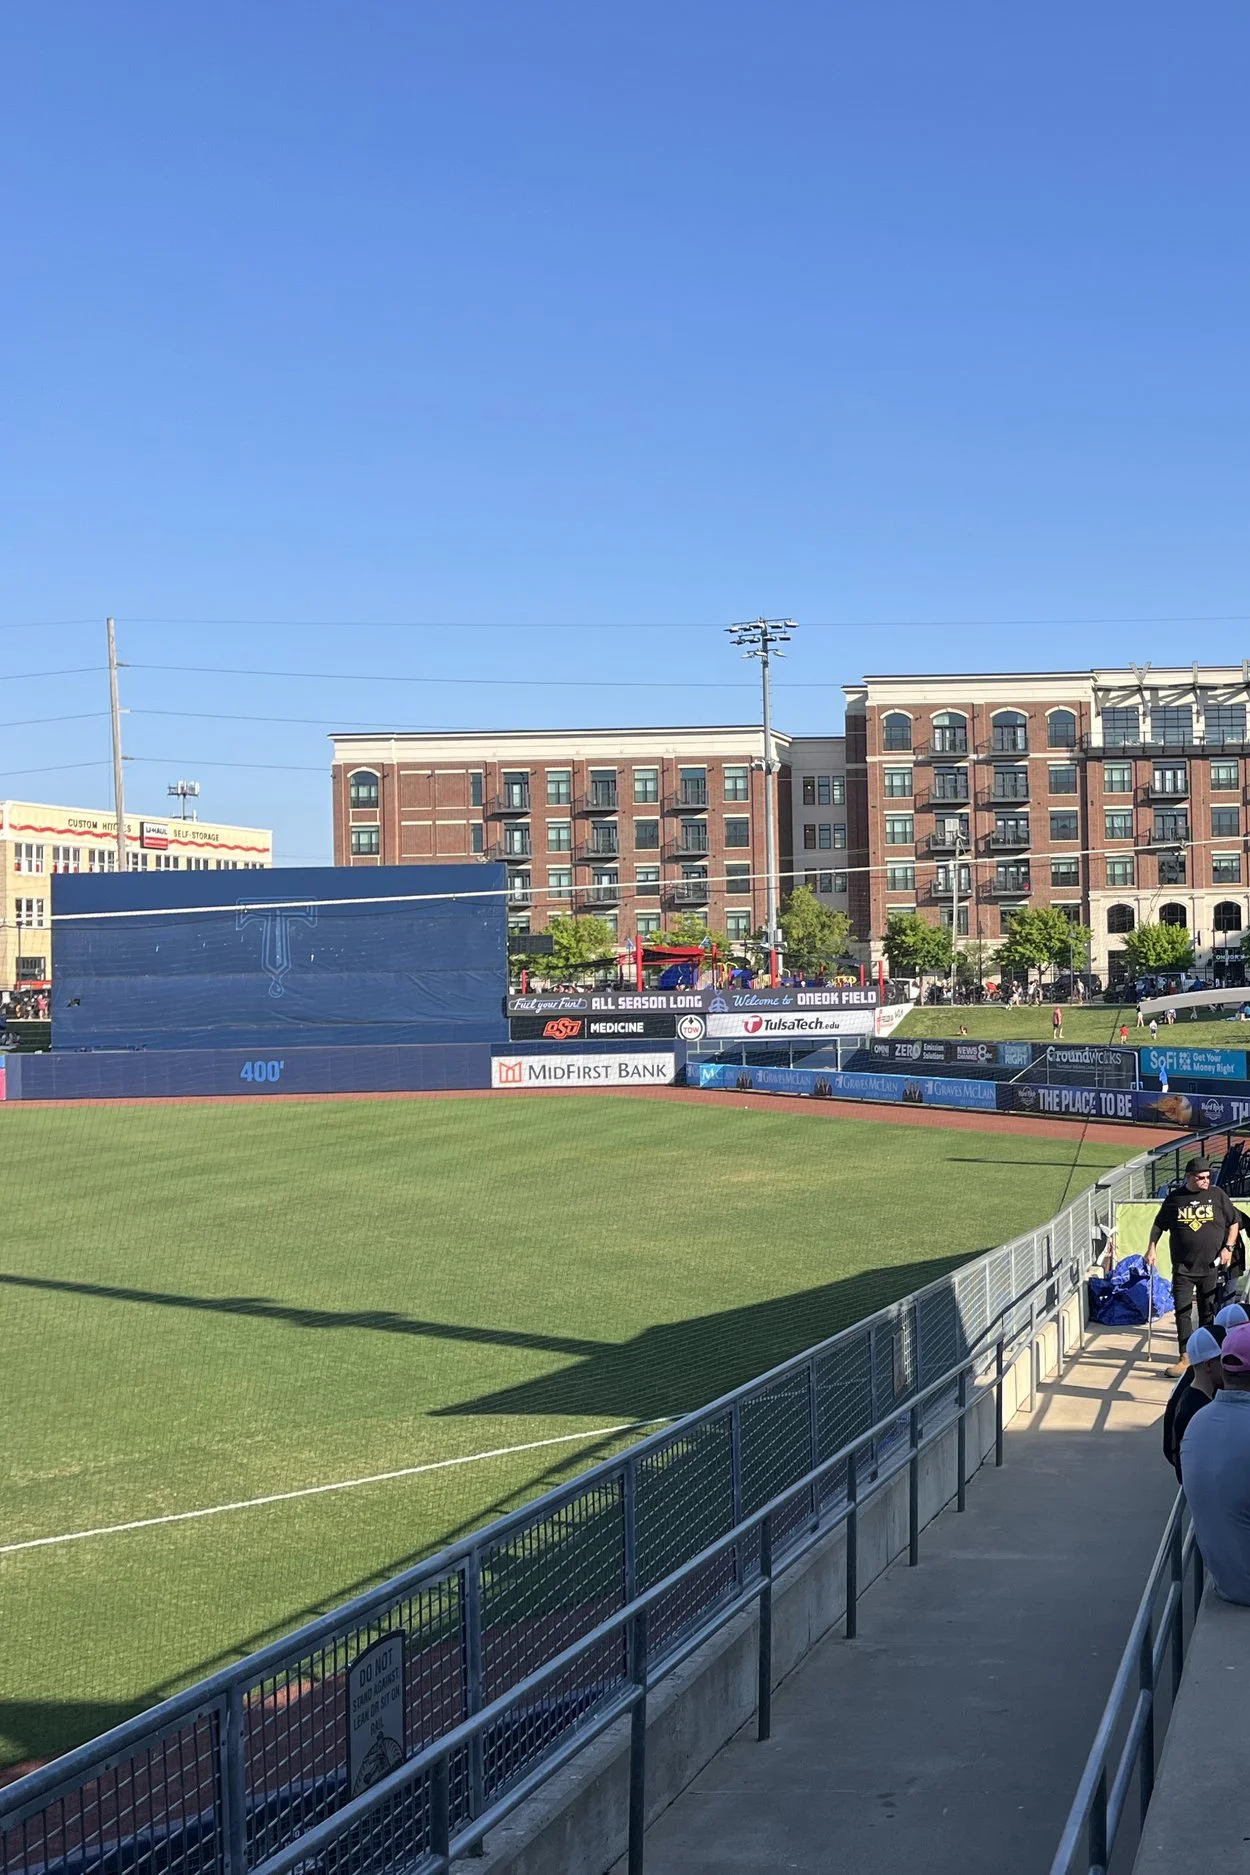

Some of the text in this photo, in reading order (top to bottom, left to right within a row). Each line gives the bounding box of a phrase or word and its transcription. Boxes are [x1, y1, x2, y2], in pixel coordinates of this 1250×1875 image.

[68, 818, 98, 829] CUSTOM
[173, 829, 219, 841] SELF-STORAGE
[514, 998, 536, 1010] Fuel
[537, 1001, 559, 1014] your
[592, 997, 615, 1010] ALL
[618, 996, 666, 1009] SEASON
[670, 994, 703, 1008] LONG
[732, 991, 877, 1007] Welcome to ONEOK FIELD
[543, 1017, 582, 1039] OSU
[590, 1022, 644, 1033] MEDICINE
[683, 1026, 699, 1034] TDW
[764, 1015, 840, 1031] TulsaTech.edu
[957, 1046, 977, 1054] NEWS
[1193, 1052, 1222, 1063] Get Your
[618, 1062, 667, 1079] BANK
[1193, 1062, 1215, 1073] Money
[1038, 1089, 1132, 1117] THE PLACE TO BE
[1177, 1206, 1214, 1219] NLCS
[359, 1648, 393, 1688] DO NOT
[353, 1667, 399, 1713] STAND AGAINST
[353, 1710, 370, 1731] LEAN
